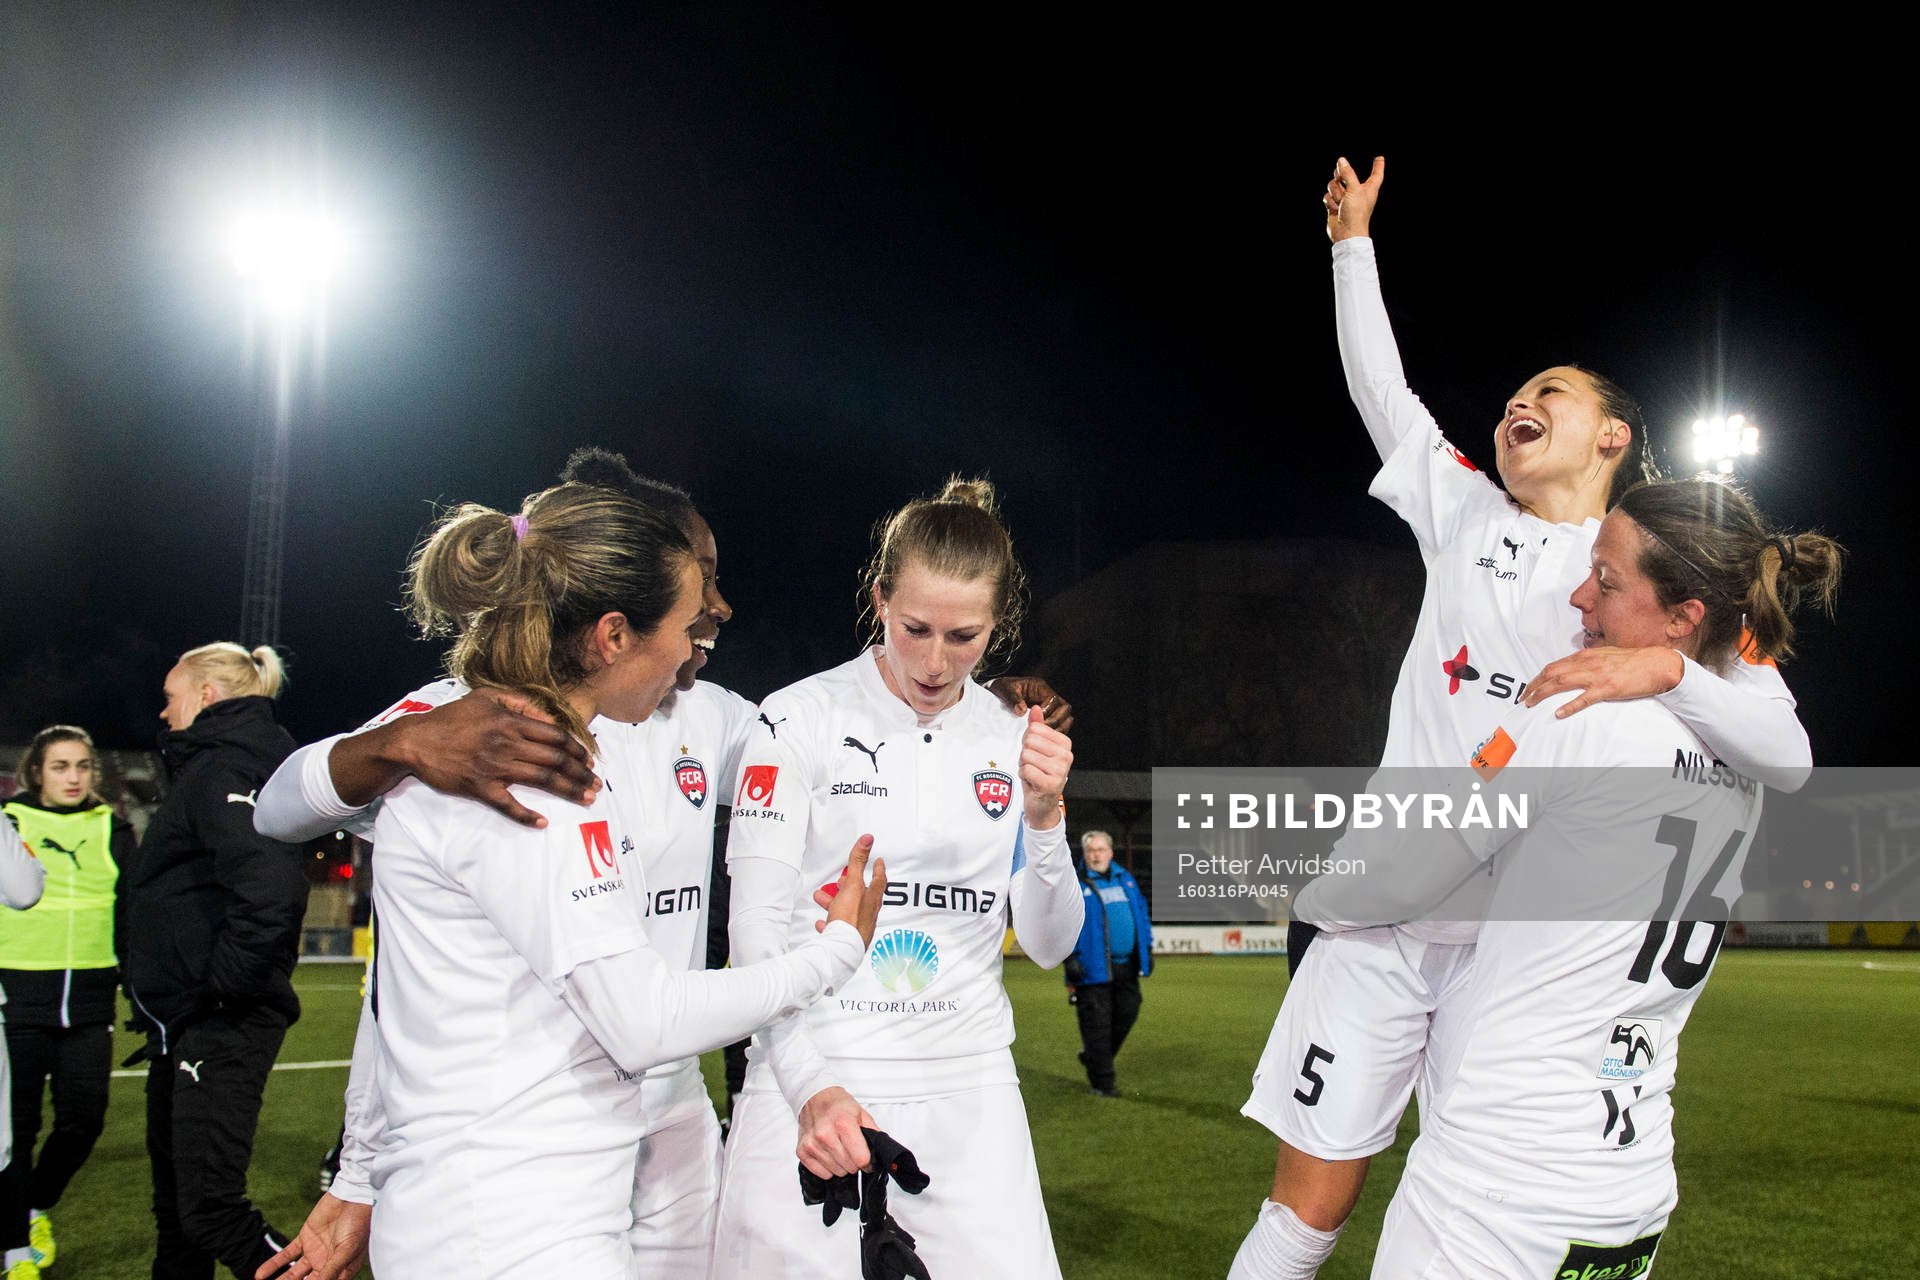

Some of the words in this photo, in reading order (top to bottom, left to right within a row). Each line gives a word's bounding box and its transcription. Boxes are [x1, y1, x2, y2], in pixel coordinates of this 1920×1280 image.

[679, 771, 703, 786] FCR
[830, 781, 888, 798] stadium
[979, 782, 1009, 798] FCR
[761, 811, 786, 822] SPEL
[571, 881, 621, 902] SVENSKA
[1627, 814, 1747, 990] 16
[839, 1000, 917, 1013] VICTORIA
[922, 1000, 958, 1012] PARK
[1602, 1058, 1624, 1067] OTTO
[1293, 1042, 1336, 1107] 5
